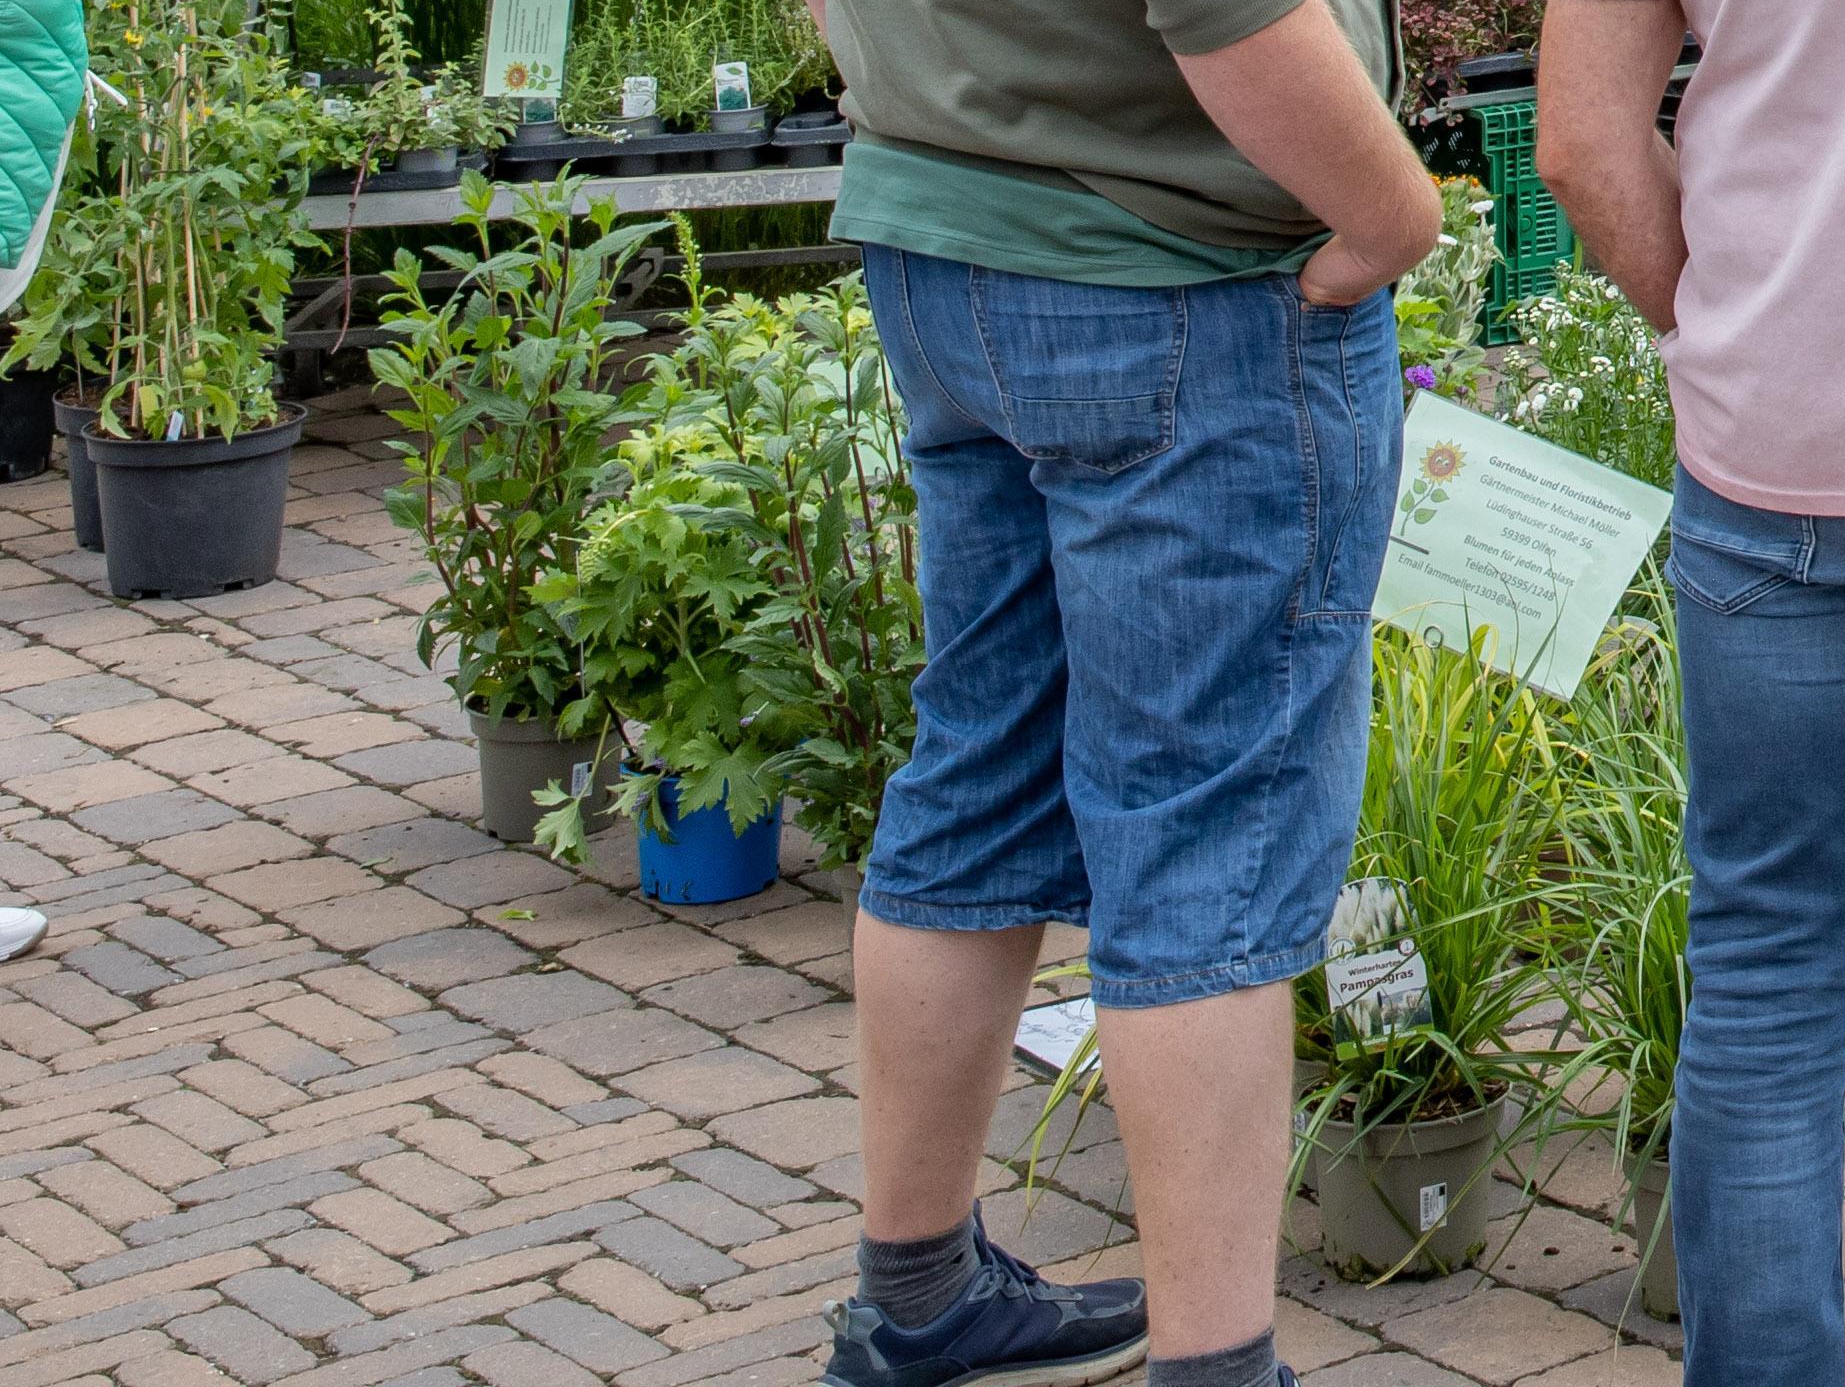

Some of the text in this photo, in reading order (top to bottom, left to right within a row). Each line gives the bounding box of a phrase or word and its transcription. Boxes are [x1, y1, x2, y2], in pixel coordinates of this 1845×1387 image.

[1479, 473, 1621, 539] Gärtnermeister Michael Möller
[1488, 455, 1632, 521] Gartenbau und Floristikbetrieb
[1486, 498, 1593, 549] Lüdinghauser Straße 56
[1500, 527, 1558, 557] 59399 Olfen
[1398, 553, 1425, 575] Email
[1463, 534, 1575, 587] Blumen für jeden Anlass
[1465, 557, 1555, 602] Telefon 02595/1248
[1340, 968, 1414, 994] Pampasgras
